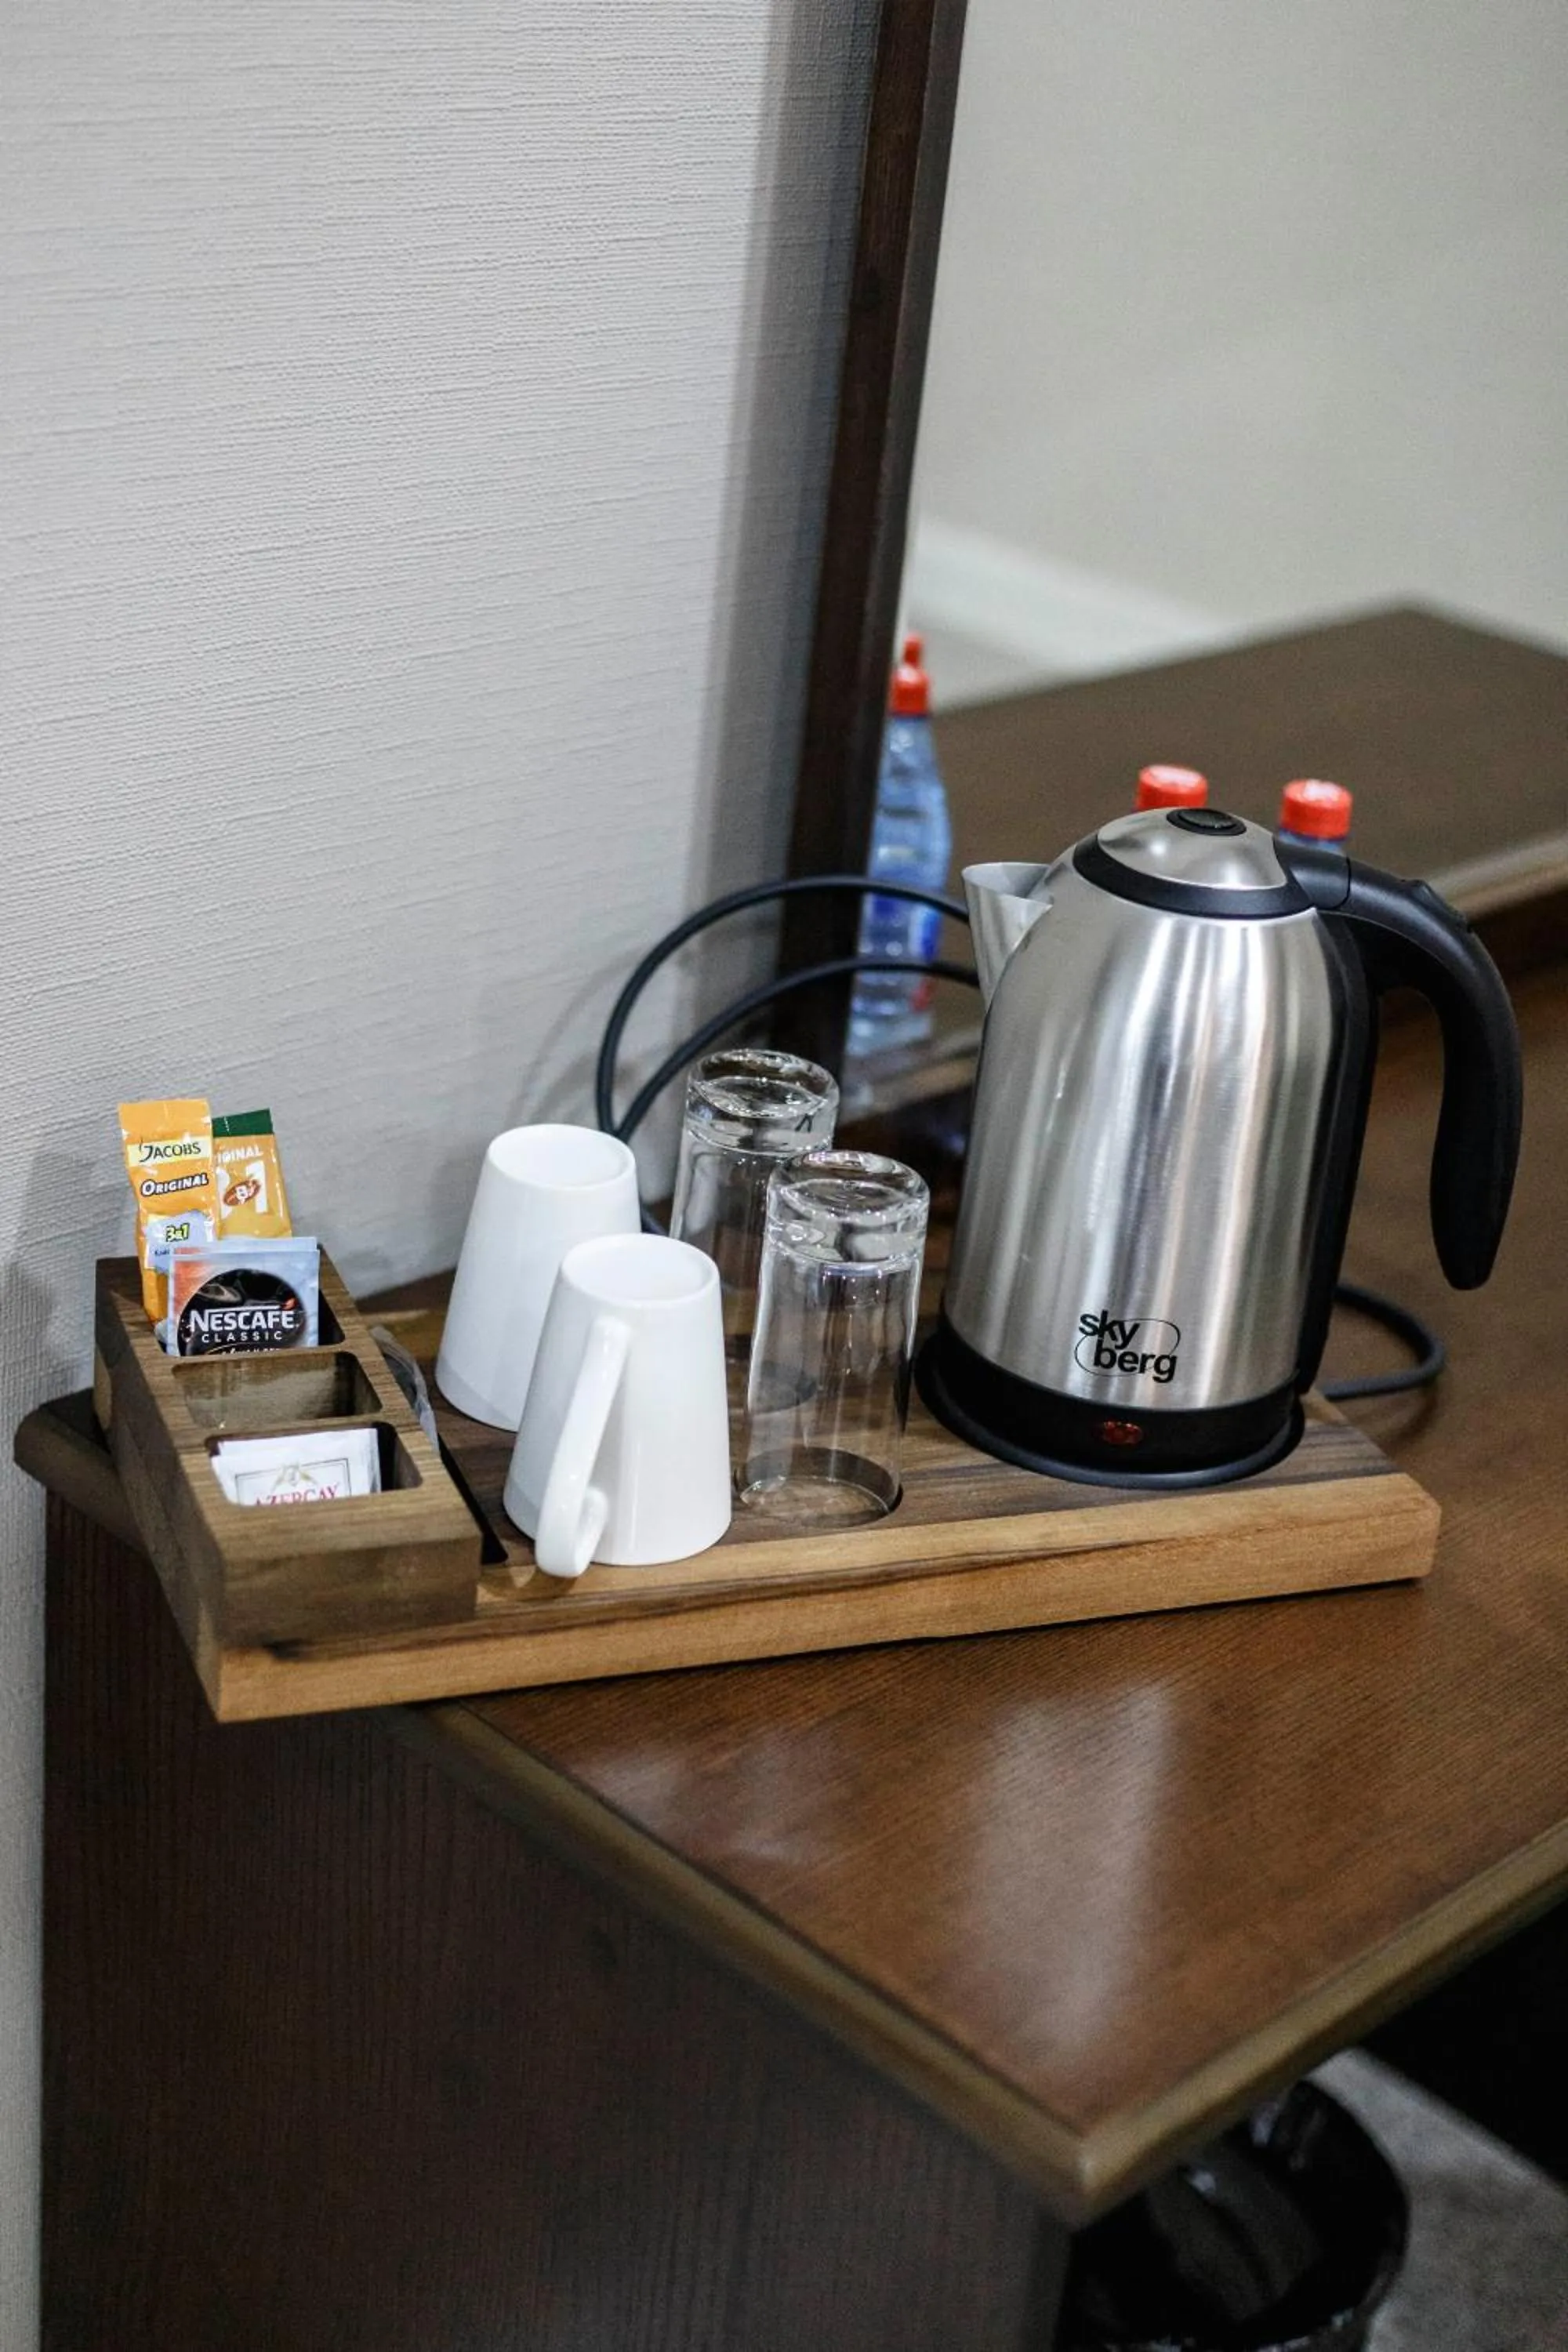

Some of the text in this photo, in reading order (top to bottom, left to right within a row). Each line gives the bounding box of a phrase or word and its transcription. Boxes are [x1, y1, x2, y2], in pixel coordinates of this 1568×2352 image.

[139, 1140, 201, 1163] JACOBS
[216, 1145, 264, 1163] IGINAL
[141, 1173, 209, 1196] ORIGINAL
[201, 1331, 282, 1343] CLASSIC
[1078, 1309, 1140, 1349] sky
[1093, 1339, 1178, 1383] berg
